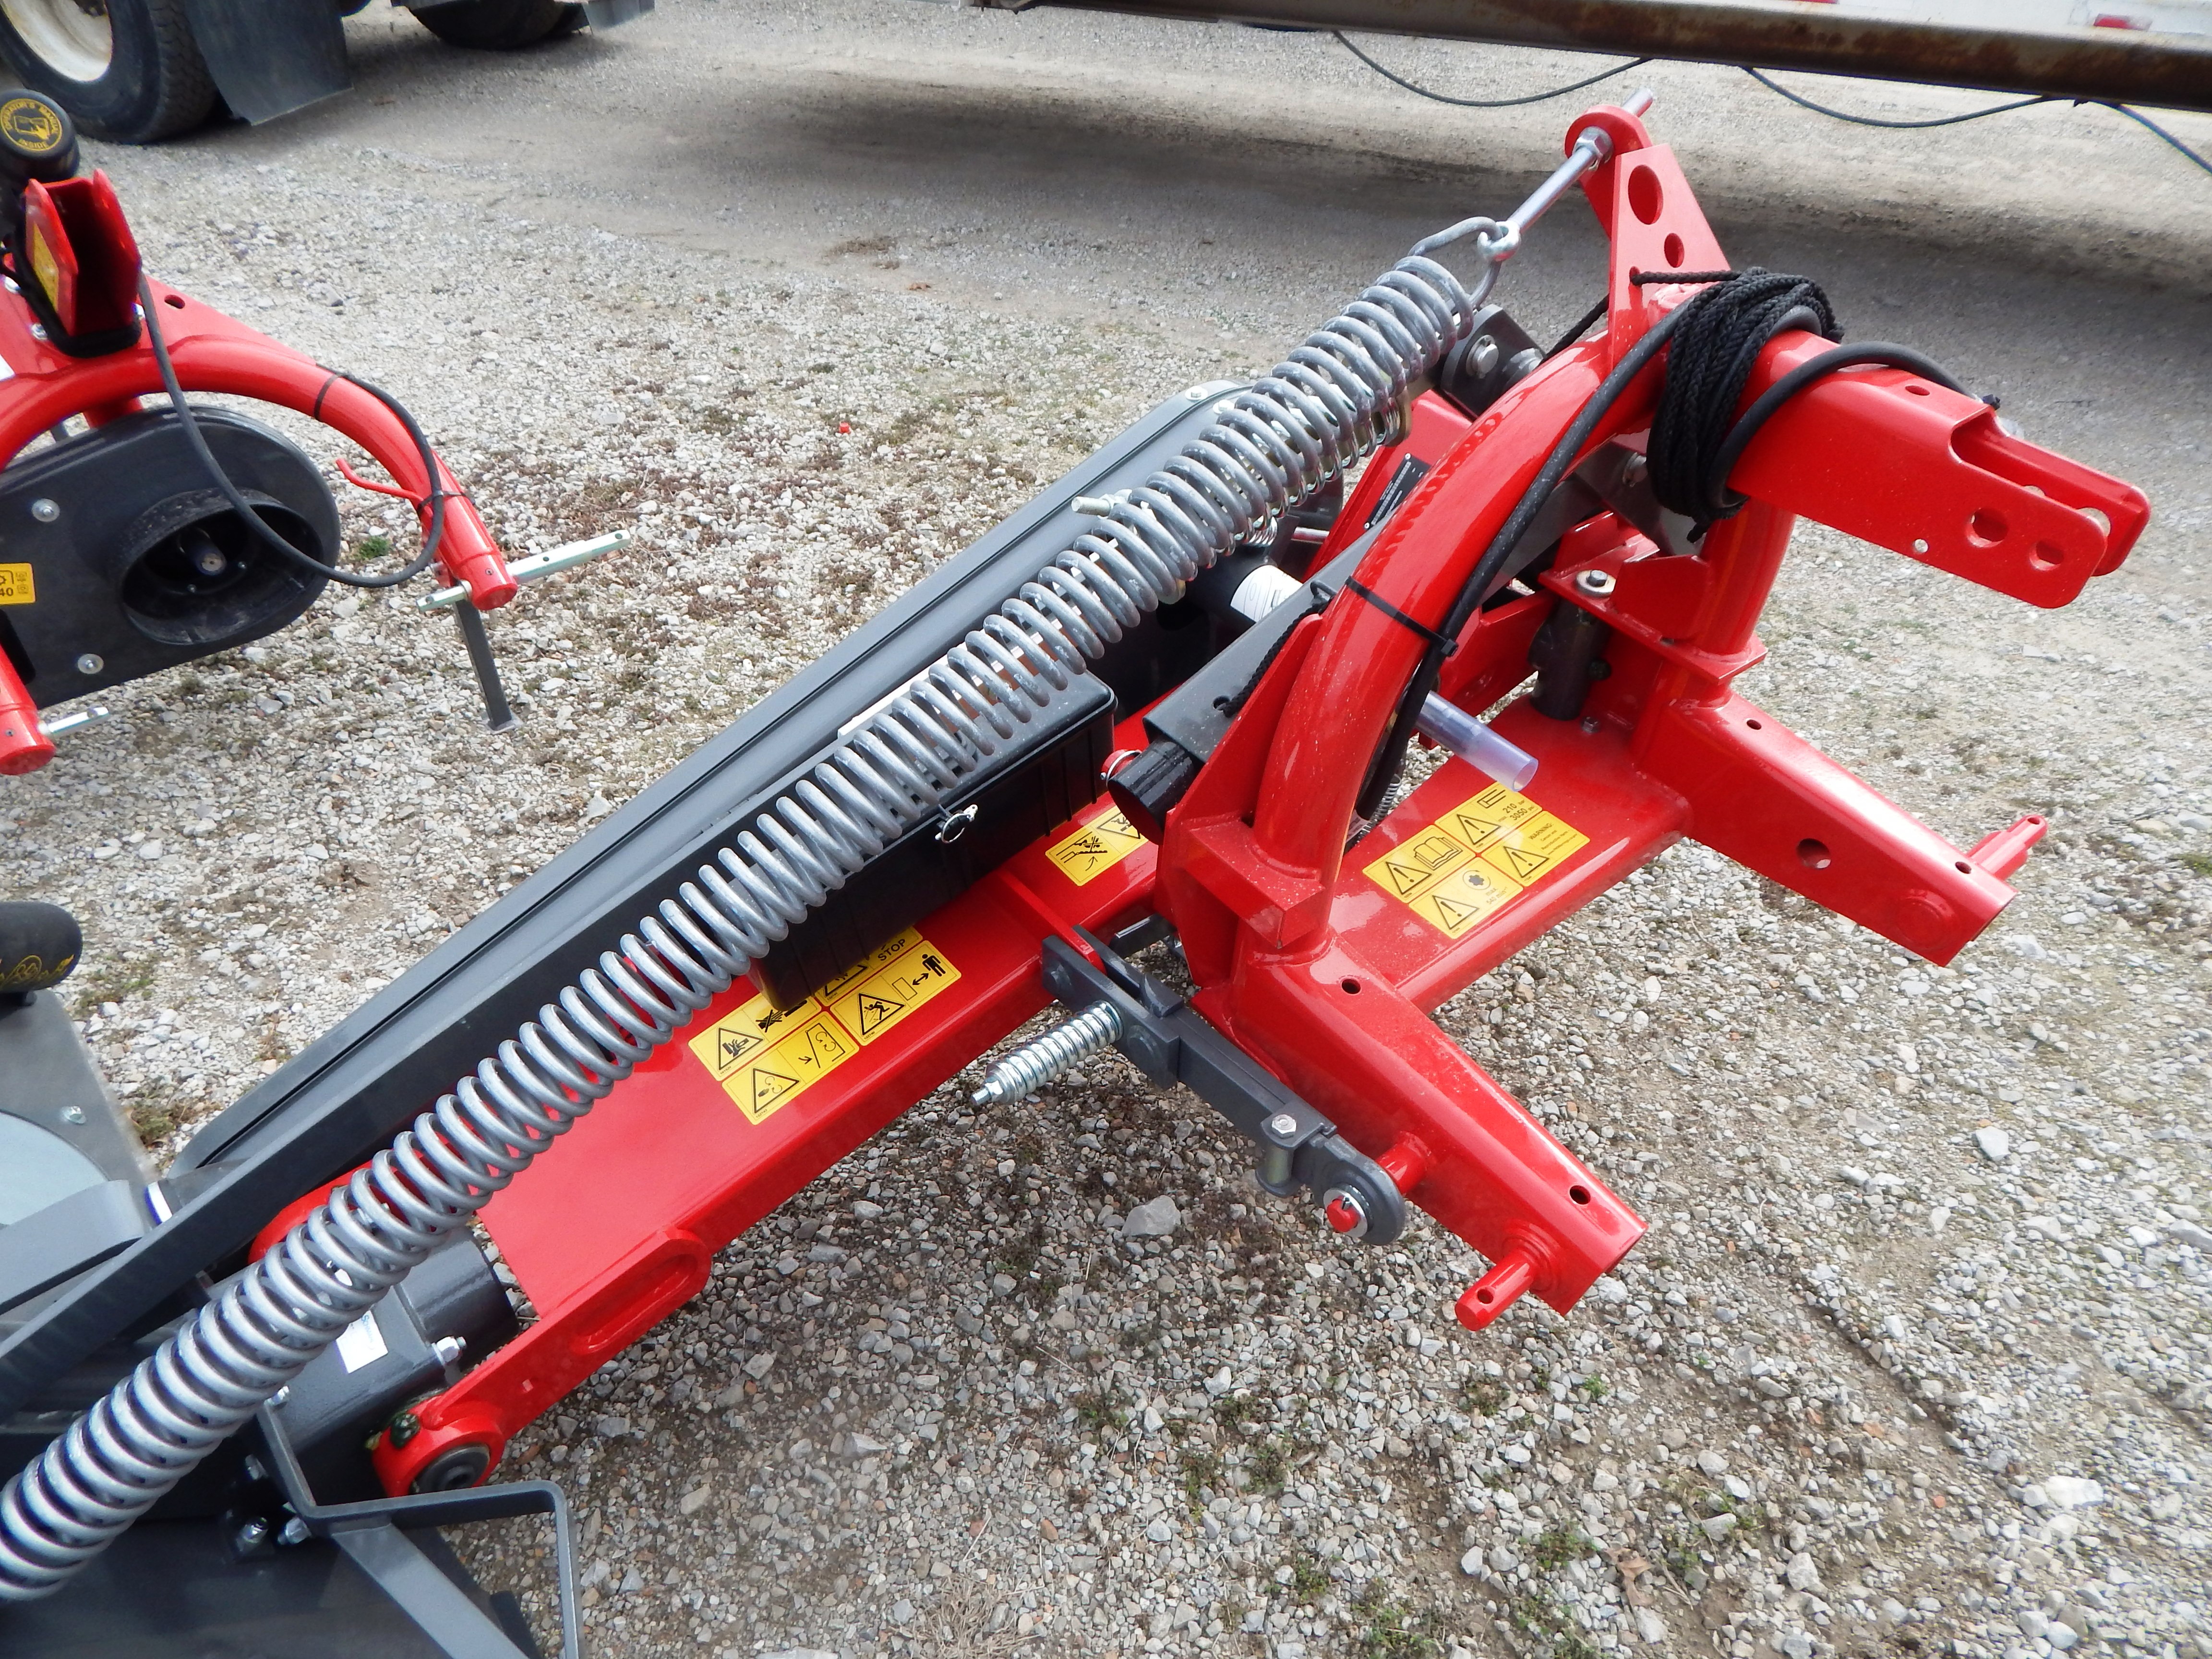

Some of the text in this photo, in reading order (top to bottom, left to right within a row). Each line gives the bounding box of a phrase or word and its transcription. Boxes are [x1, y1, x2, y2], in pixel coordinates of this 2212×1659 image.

[39, 106, 59, 134] MANUAL
[18, 138, 48, 149] INSIDE
[1503, 803, 1517, 813] 210
[1510, 808, 1527, 820] 3050
[878, 938, 905, 961] STOP
